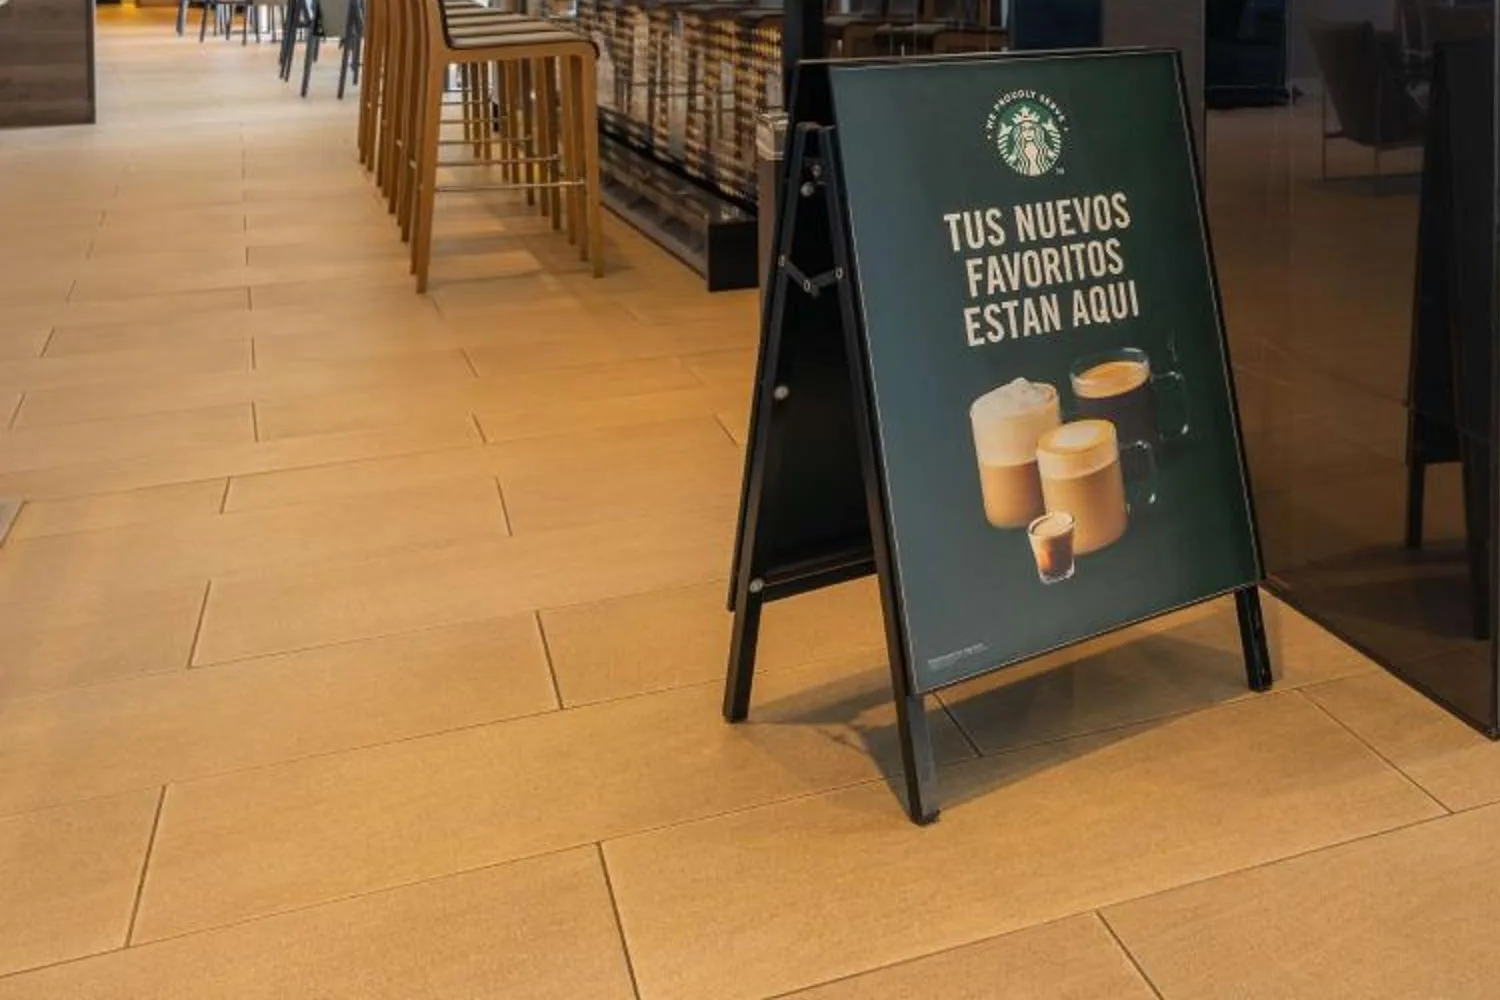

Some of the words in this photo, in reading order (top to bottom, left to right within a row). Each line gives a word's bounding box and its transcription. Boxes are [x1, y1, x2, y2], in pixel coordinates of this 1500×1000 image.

[993, 89, 1037, 111] PROUDLY
[943, 207, 1006, 252] TUS
[1013, 192, 1131, 243] NUEVOS
[965, 237, 1124, 298] FAVORITOS
[963, 293, 1063, 347] ESTAN
[1072, 279, 1140, 328] AQUI
